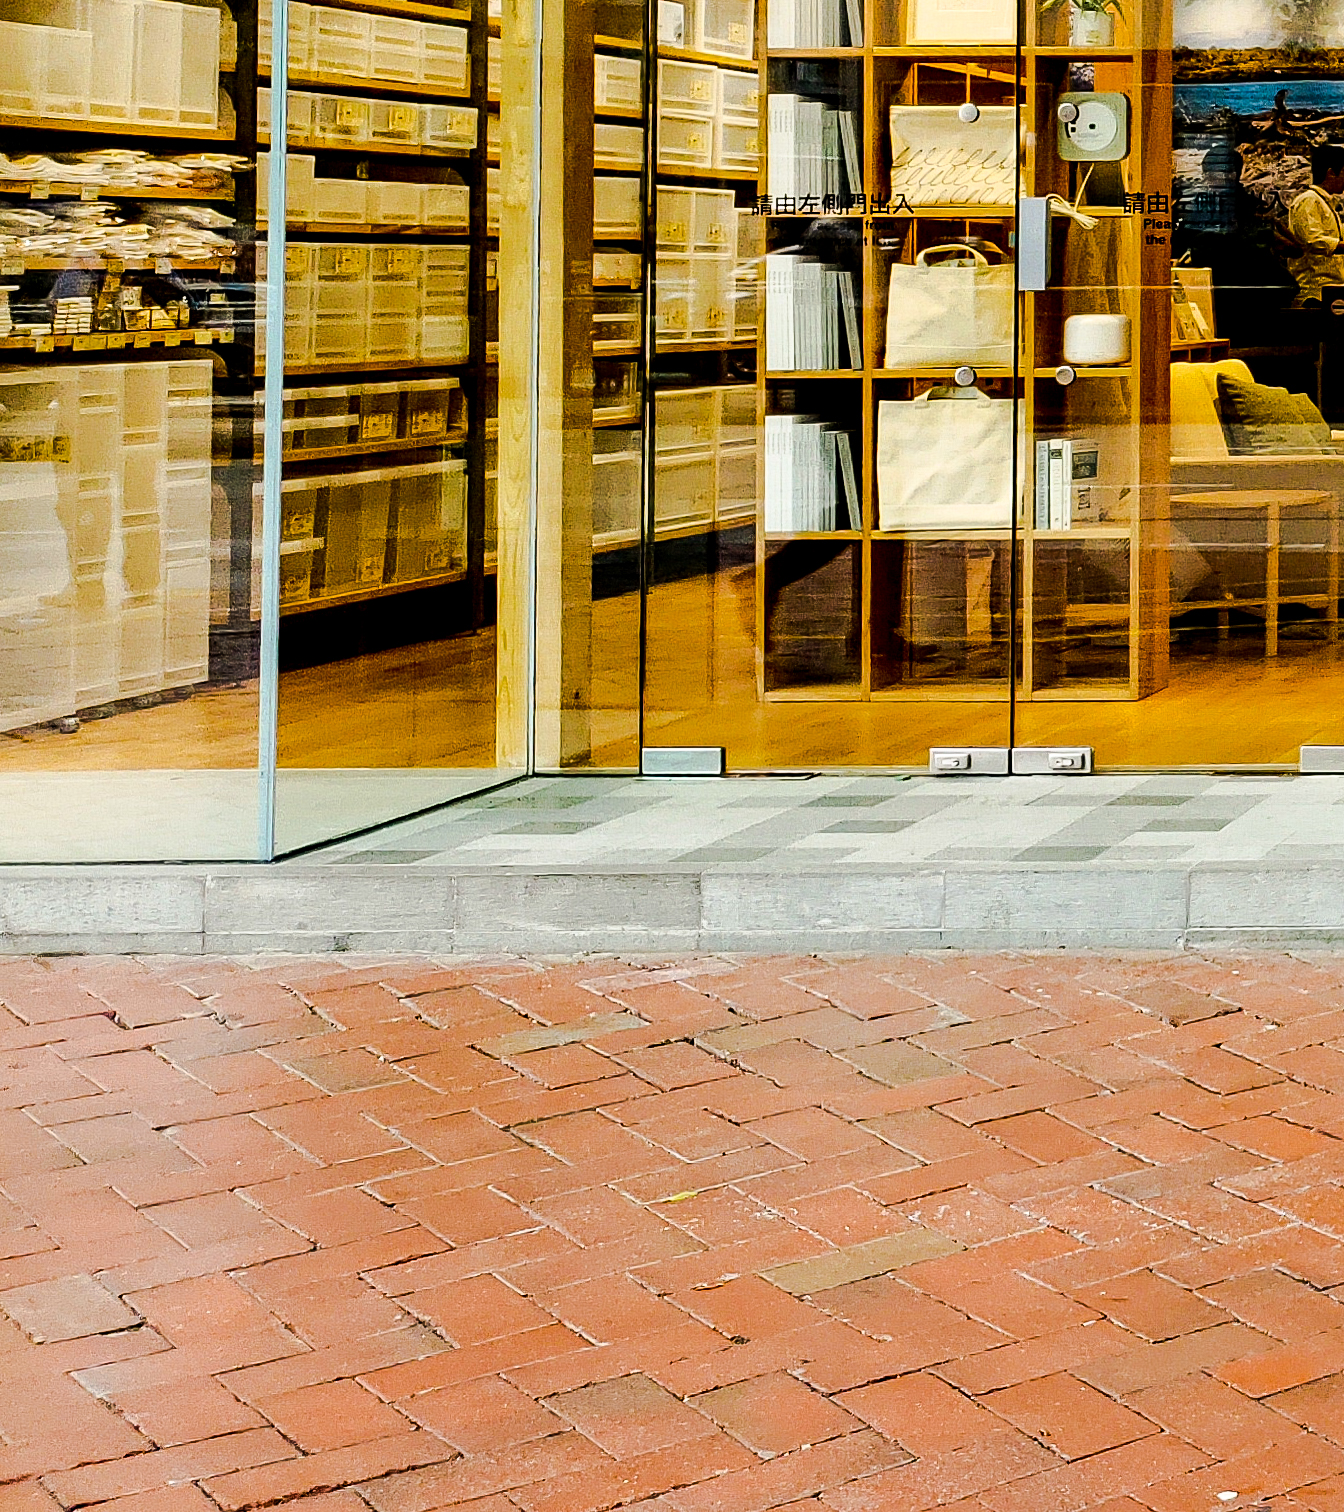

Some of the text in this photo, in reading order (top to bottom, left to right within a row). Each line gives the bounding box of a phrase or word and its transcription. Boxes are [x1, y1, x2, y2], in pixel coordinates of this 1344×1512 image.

[751, 192, 915, 216] 請由左側門出入
